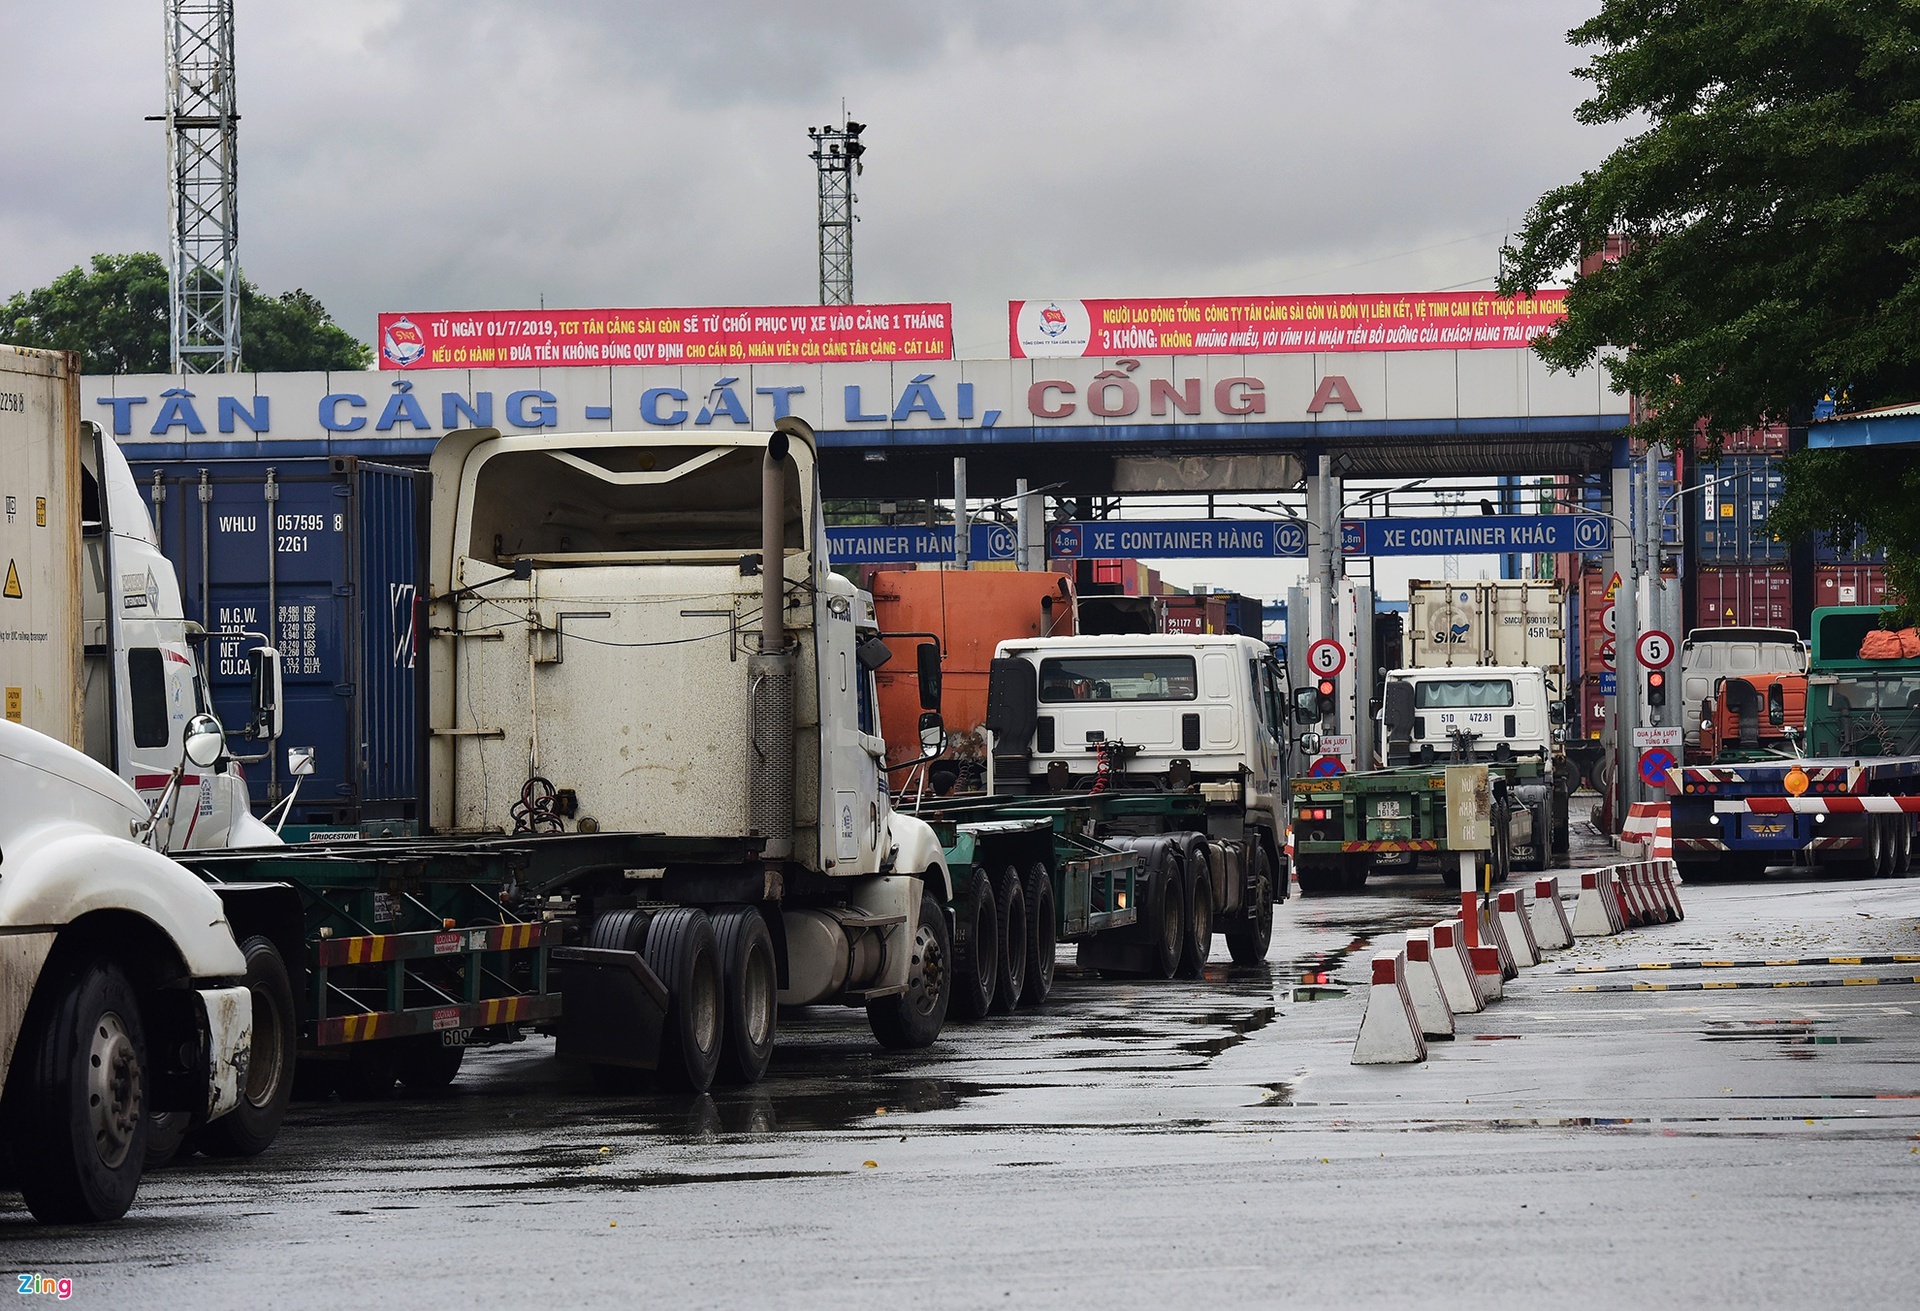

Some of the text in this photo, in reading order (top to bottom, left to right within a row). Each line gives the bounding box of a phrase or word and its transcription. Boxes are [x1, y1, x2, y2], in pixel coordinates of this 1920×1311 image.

[1103, 296, 1567, 326] NGƯỜI LAO ĐỘNG TỔNG CÔNG TY TÂN CẢNG SÀI GÒN VÀ ĐƠN VỊ LIÊN KẾT, VỆ TINH CAM KẾT THỰC HIỆN NGHIÊ
[432, 309, 944, 338] TỪ NGÀY 01/7/2019, TCT TÂN CẢNG SÀI GÒN SẼ TỪ CHỐI PHỤC VỤ XE VÀO CẢNG 1 THÁNG
[1113, 325, 1157, 348] KHÔNG:
[1160, 330, 1191, 347] KHÔNG
[1195, 328, 1228, 347] NHŨNG
[1228, 325, 1259, 349] NHIỄU,
[1262, 327, 1278, 346] VÒI
[1280, 327, 1302, 346] VĨNH
[1304, 326, 1316, 345] VÀ
[1317, 326, 1345, 349] NHẬN
[1346, 323, 1368, 344] TIỀN
[1368, 323, 1385, 344] BỒI
[1386, 324, 1418, 344] DƯỠNG
[1420, 322, 1438, 343] CỦA
[1440, 322, 1472, 342] KHÁCH
[1474, 323, 1500, 341] HÀNG
[1503, 321, 1524, 340] TRÁI
[432, 344, 451, 363] NẾU
[454, 345, 467, 362] CÓ
[469, 345, 495, 362] HÀNH
[497, 347, 507, 361] VI
[510, 345, 531, 361] ĐƯA
[534, 340, 560, 361] TIỀN
[562, 341, 599, 360] KHÔNG
[601, 341, 631, 359] ĐÚNG
[633, 343, 655, 361] QUY
[657, 343, 683, 361] ĐỊNH
[686, 344, 705, 358] CHO
[707, 341, 726, 357] CÁN
[729, 341, 746, 360] BỘ,
[748, 340, 774, 357] NHÂN
[777, 340, 799, 356] VIÊN
[801, 338, 822, 356] CỦA
[823, 337, 847, 355] CẢNG
[849, 339, 868, 355] TÂN
[870, 337, 895, 355] CẢNG
[904, 338, 921, 354] CÁT
[925, 337, 943, 353] LÁI!
[97, 359, 1362, 434] TÂN CẢNG - CÁT LÁI, CỔNG A
[219, 513, 343, 532] WHLU 057595 8
[278, 536, 307, 551] 22G1
[916, 532, 1015, 554] HÀN 03
[1055, 527, 1301, 550] 4.8m XE CONTAINER HÀNG 02
[1384, 523, 1601, 547] XE CONTAINER KHÁC 01
[220, 608, 257, 623] M.G.W.
[304, 606, 316, 614] KGS
[304, 614, 315, 622] LBS
[1168, 619, 1191, 627] 951177
[1504, 616, 1558, 625] SMCU 690101 2
[220, 625, 246, 641] TARE
[304, 623, 316, 631] KGS
[1434, 631, 1466, 644] SML
[1528, 627, 1549, 638] 45R1
[220, 642, 240, 657] NET
[1322, 649, 1332, 667] 5
[1650, 641, 1660, 659] 5
[1441, 713, 1492, 723] 51D 472.81
[311, 832, 358, 841] BRIDGESTONE
